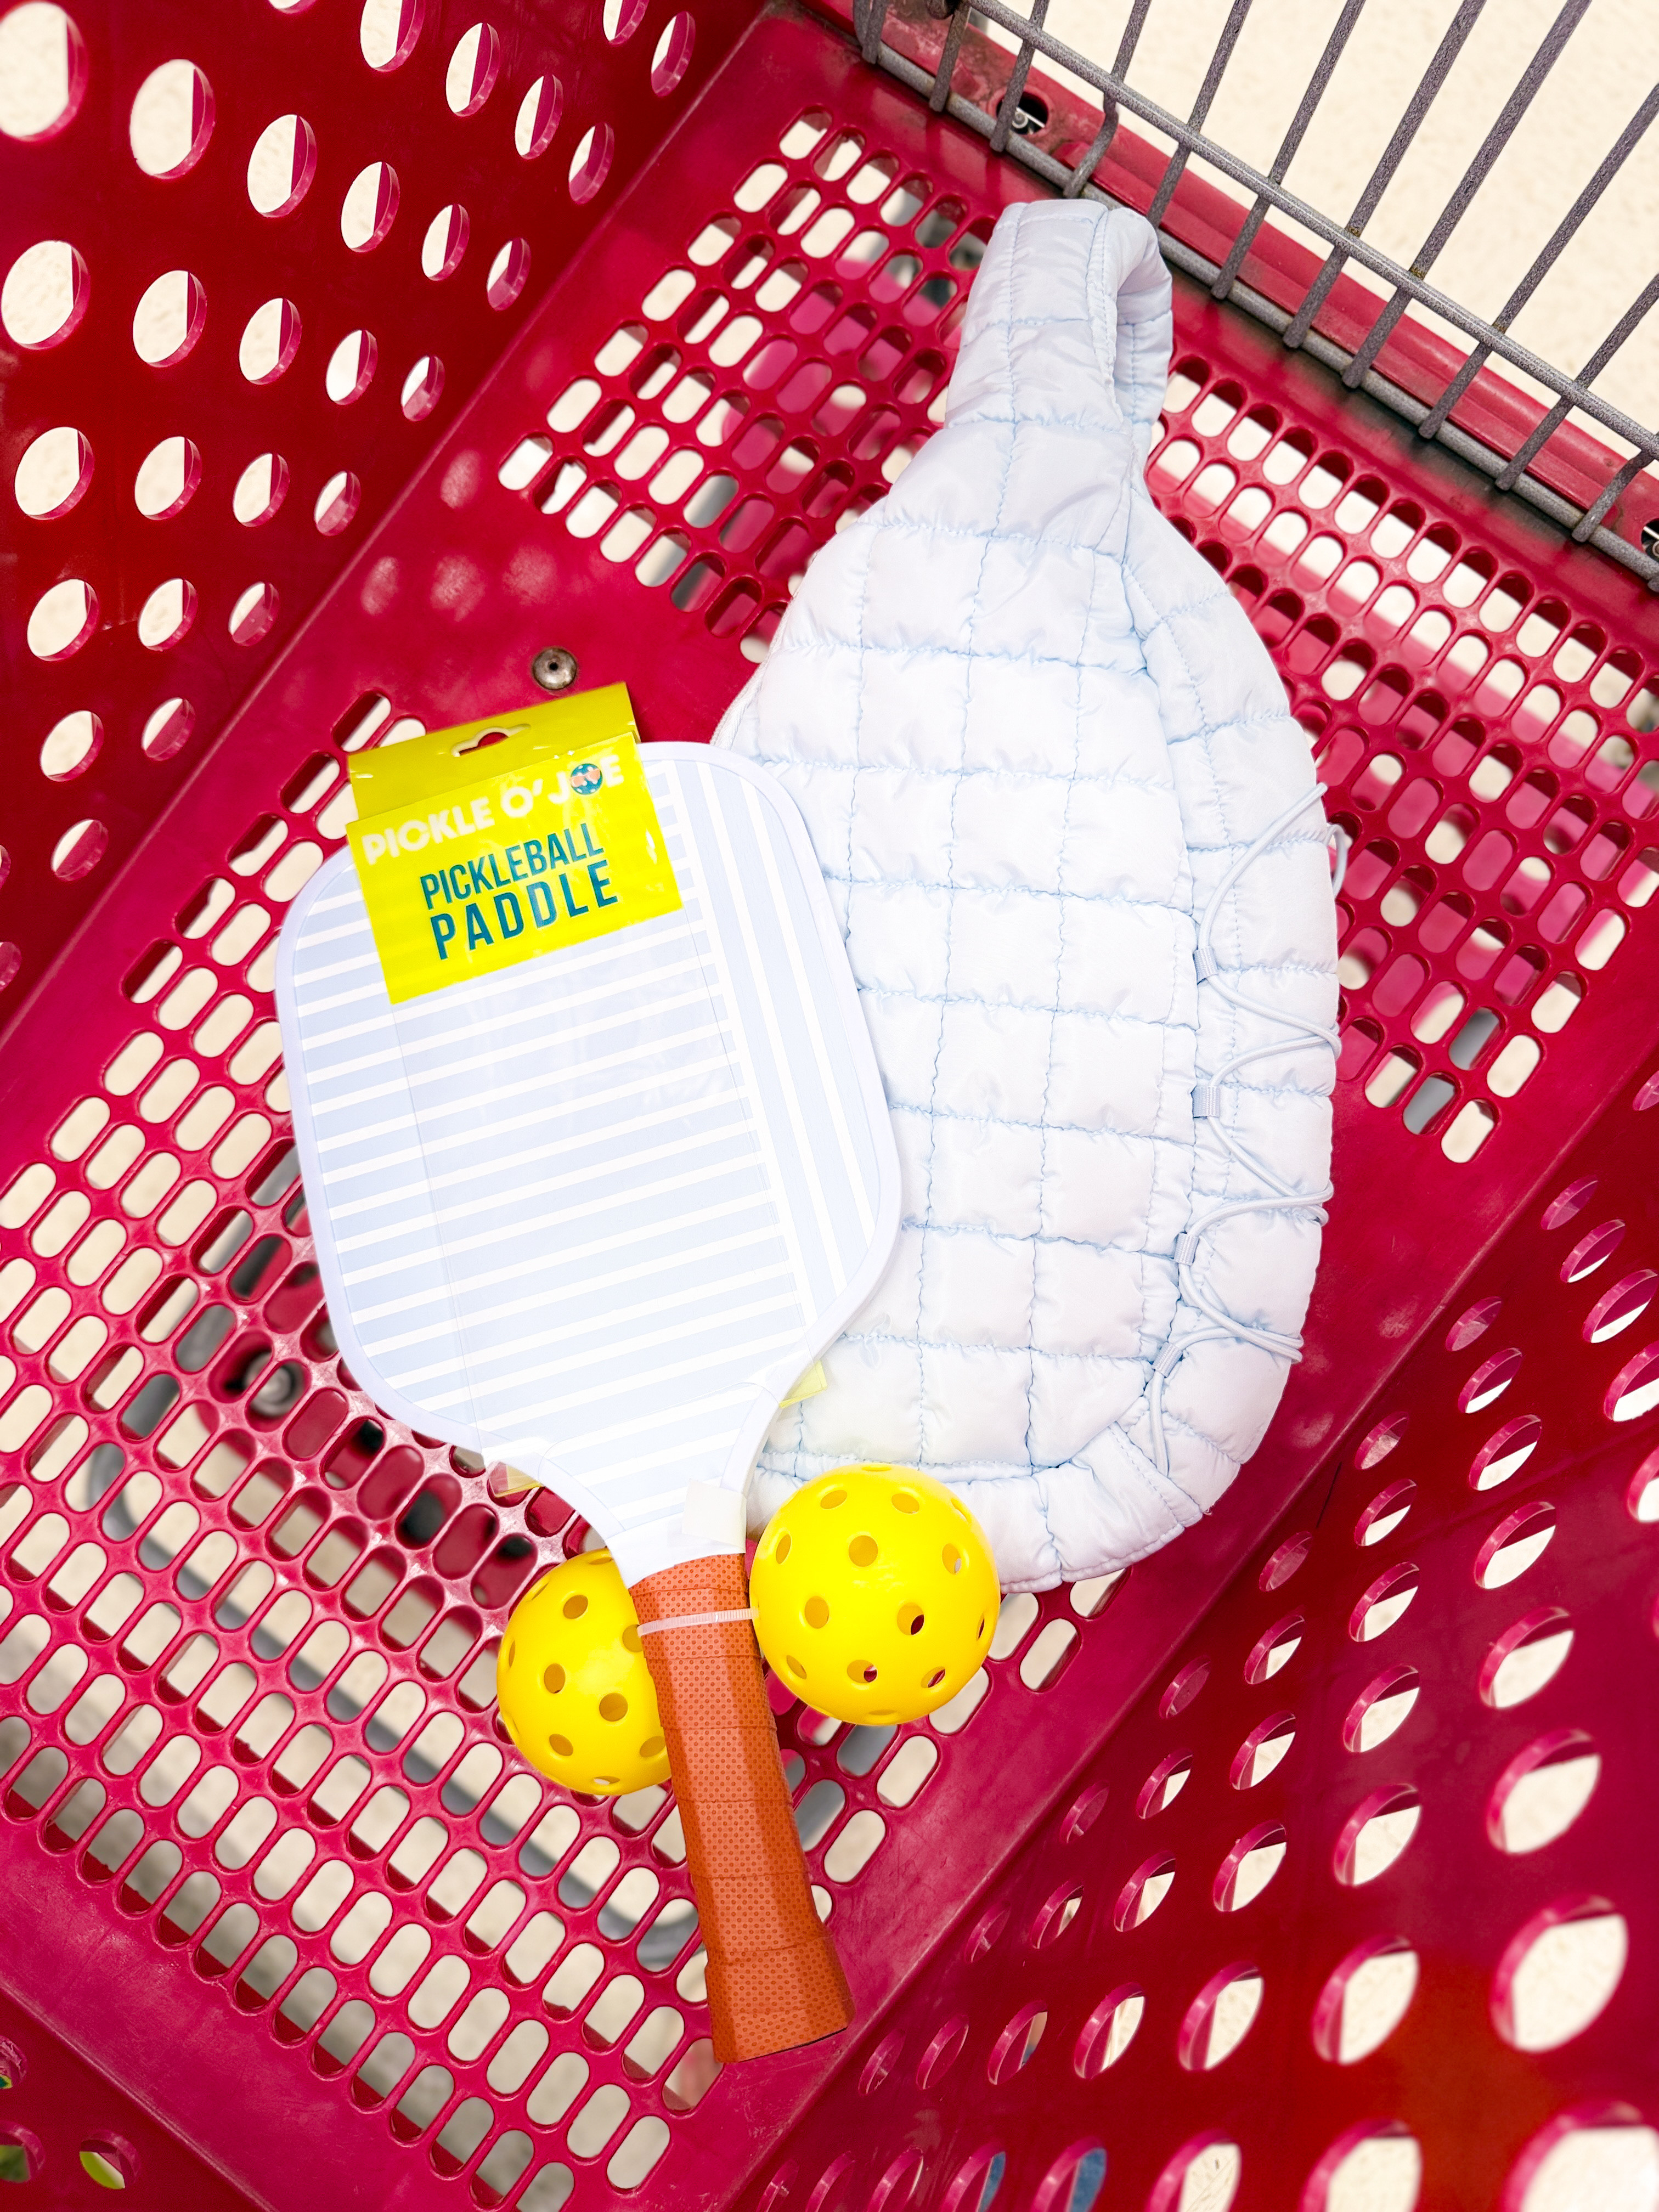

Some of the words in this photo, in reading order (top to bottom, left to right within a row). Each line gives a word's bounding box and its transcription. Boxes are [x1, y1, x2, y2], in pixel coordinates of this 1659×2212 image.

[362, 798, 493, 864] PICKLE
[549, 754, 625, 804] JOE
[420, 823, 604, 910] PICKLEBALL
[430, 859, 618, 960] PADDLE
